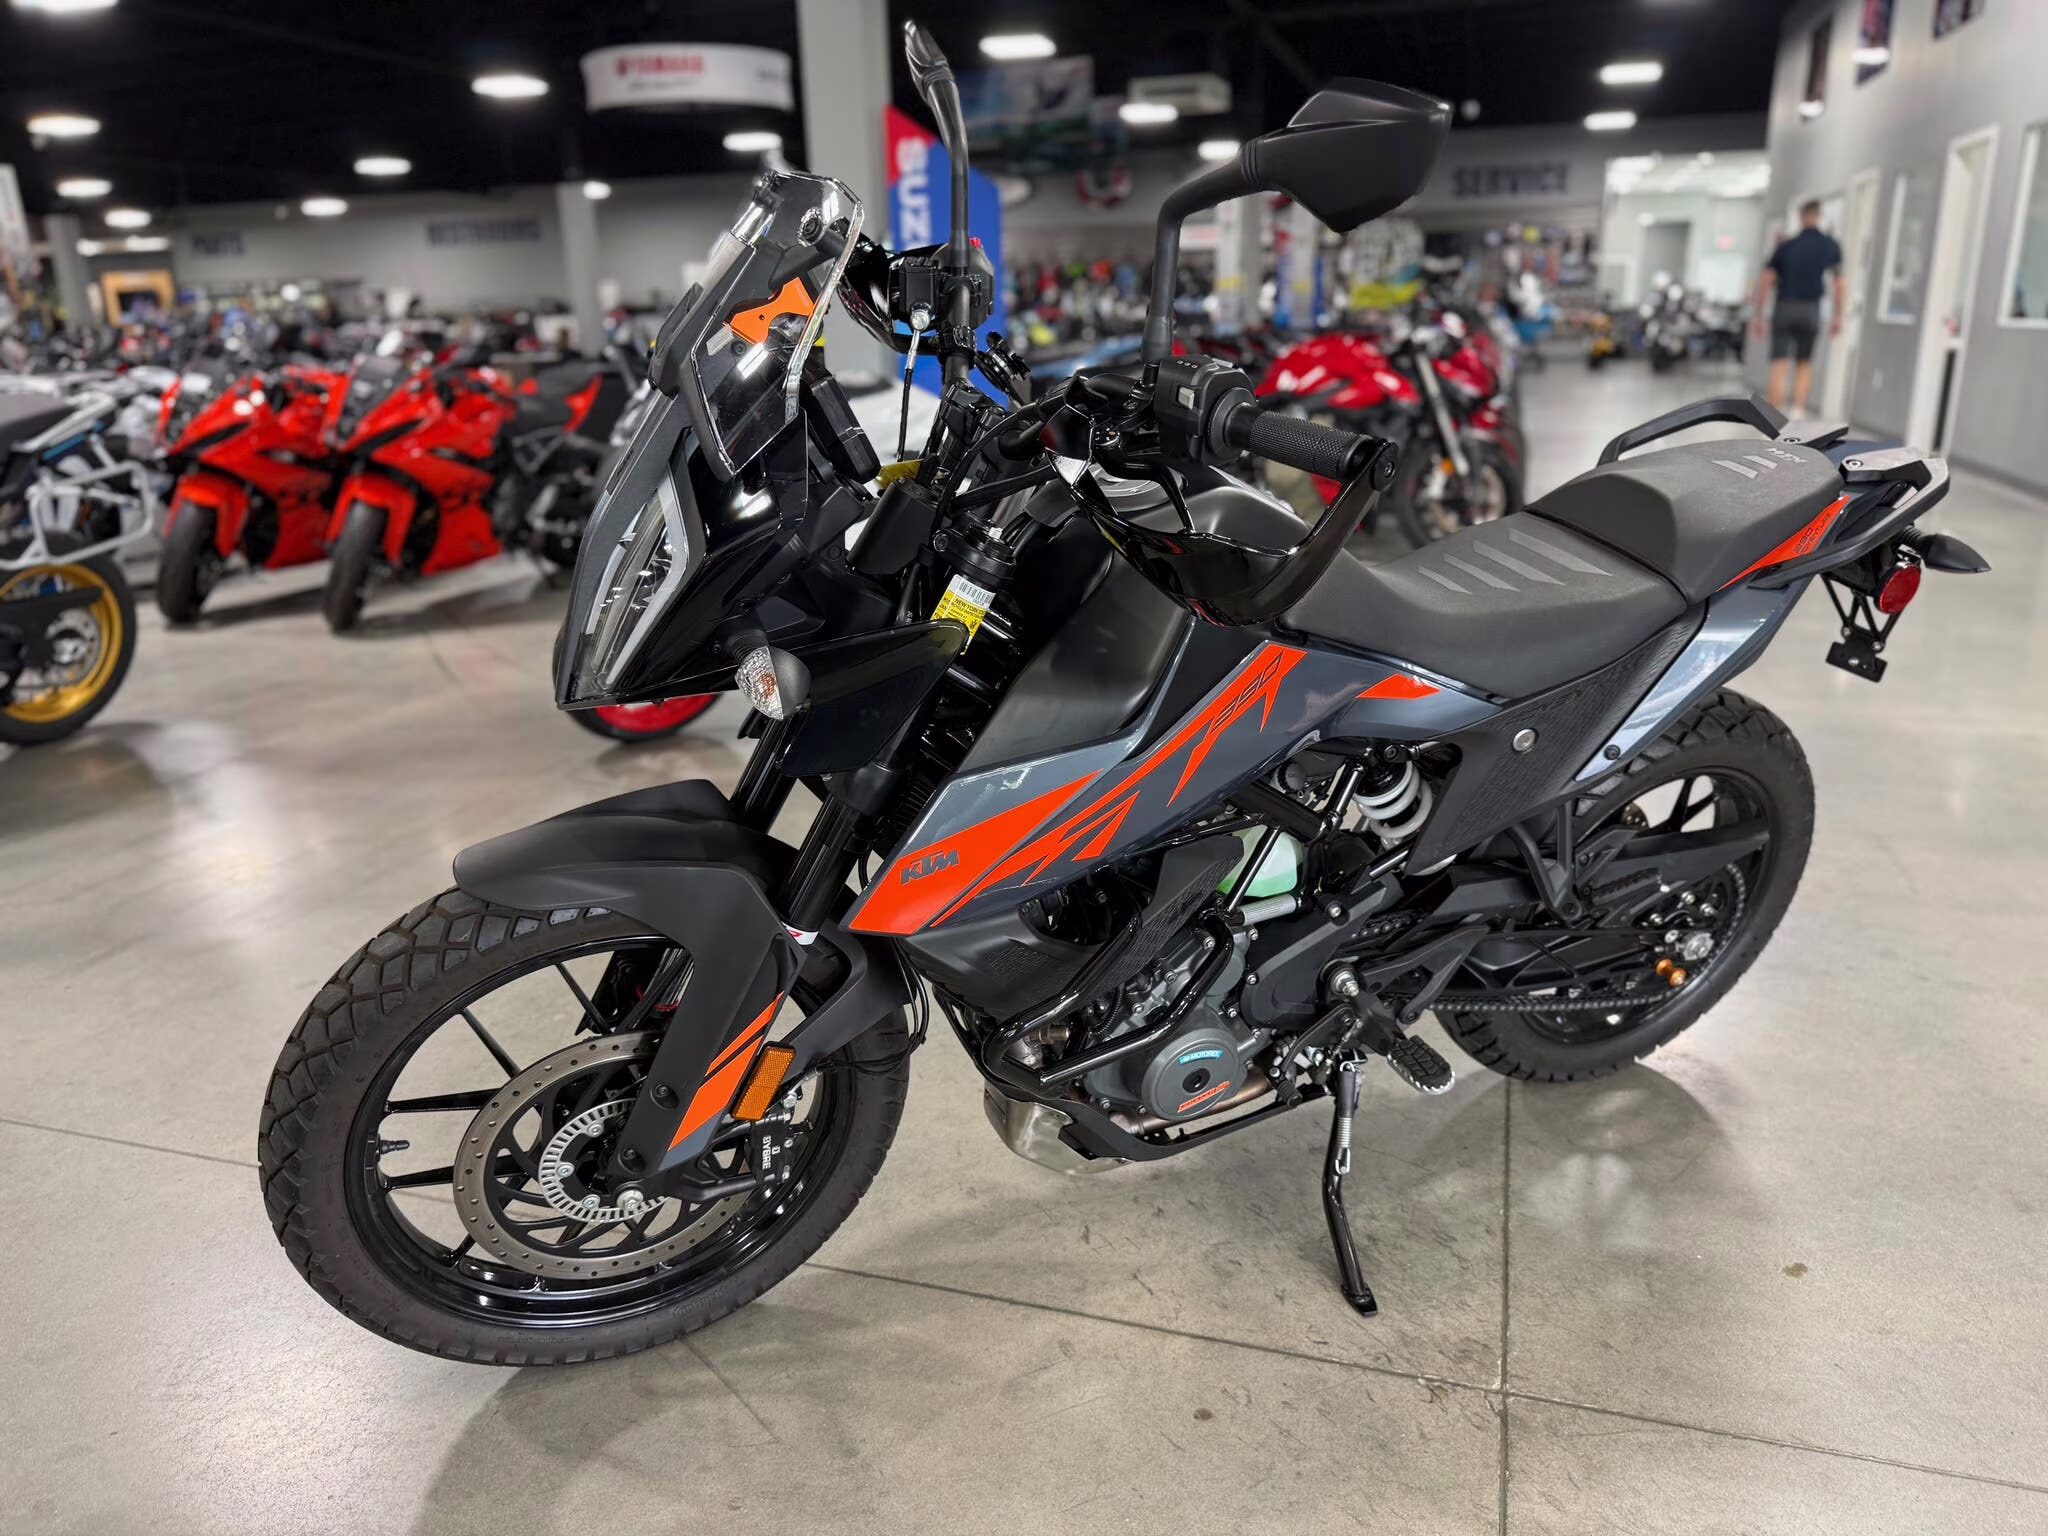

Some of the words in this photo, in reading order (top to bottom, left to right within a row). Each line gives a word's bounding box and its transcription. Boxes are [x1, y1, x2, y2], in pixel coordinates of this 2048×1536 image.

[896, 136, 931, 248] SUZ
[901, 848, 960, 884] KTM
[762, 1135, 772, 1170] BYBRE
